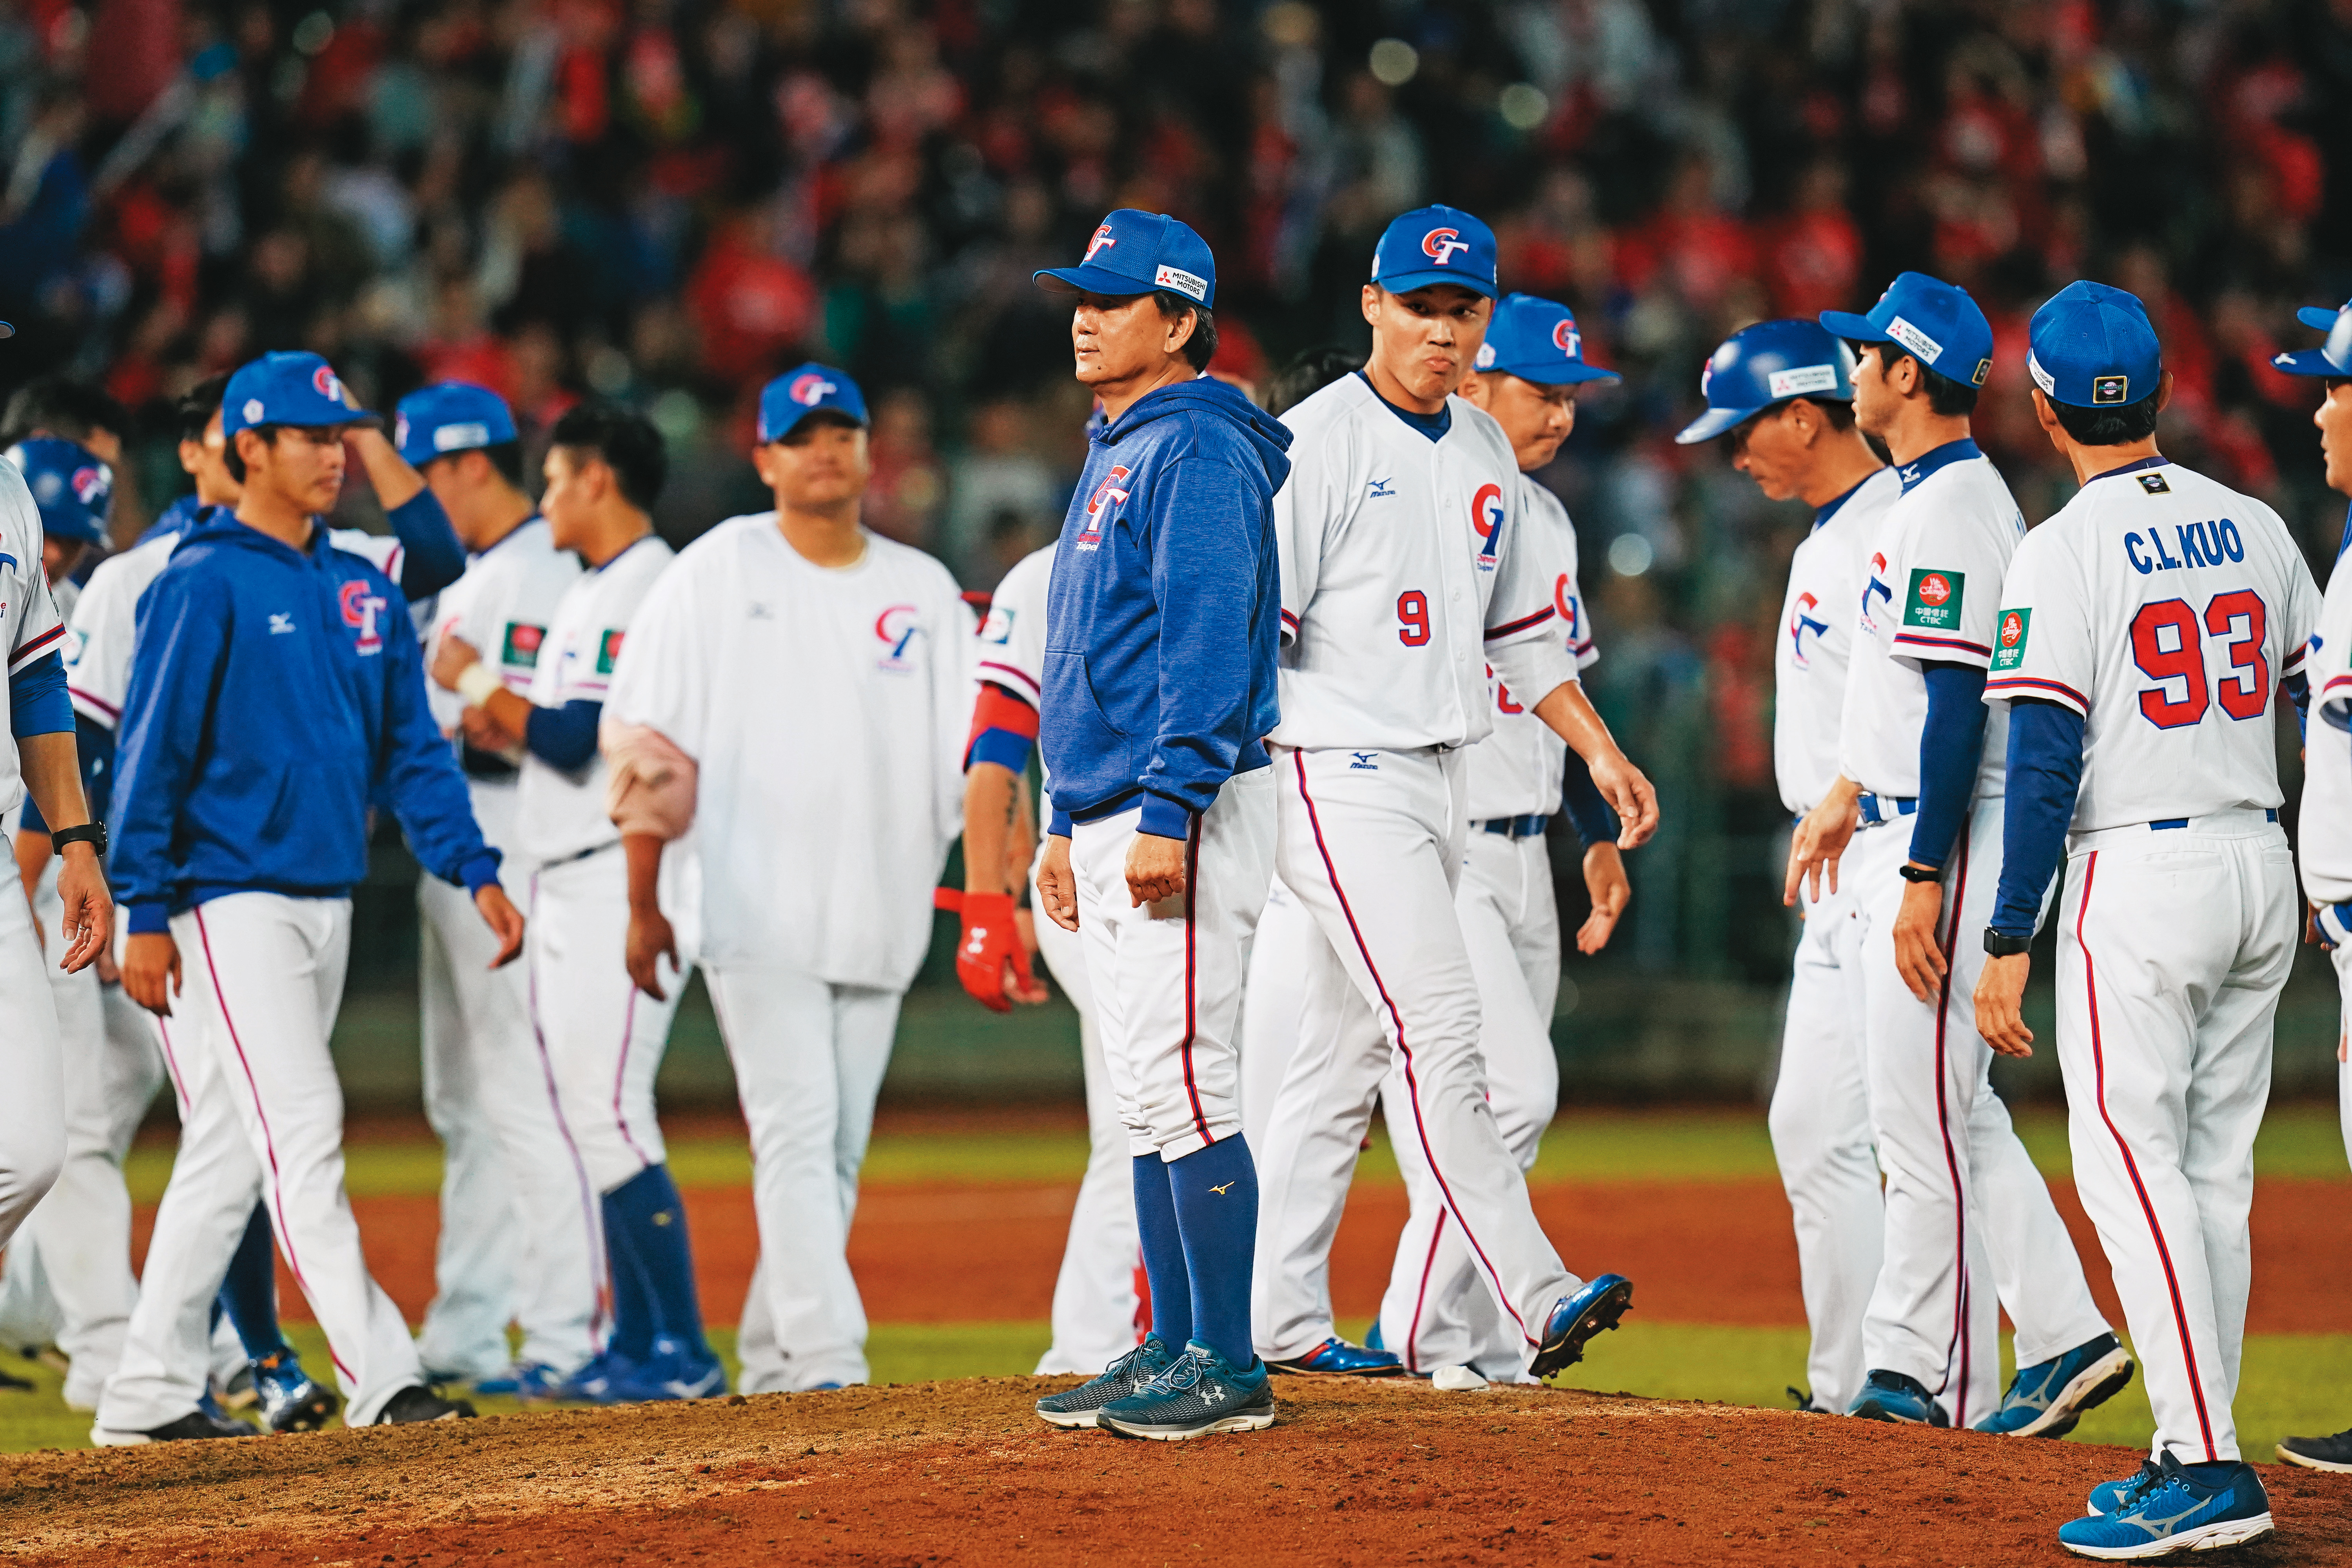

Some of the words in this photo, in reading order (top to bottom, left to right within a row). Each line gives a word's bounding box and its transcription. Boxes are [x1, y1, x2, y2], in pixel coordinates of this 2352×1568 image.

[1172, 272, 1206, 290] MITSUBISHI
[1177, 280, 1200, 295] MOTORS
[1905, 336, 1930, 357] MOTORS
[2124, 518, 2244, 575] C.L.KUO
[1397, 590, 1431, 647] 9
[1920, 616, 1942, 624] CTBC
[2000, 658, 2014, 666] CTBC
[2130, 588, 2270, 730] 93
